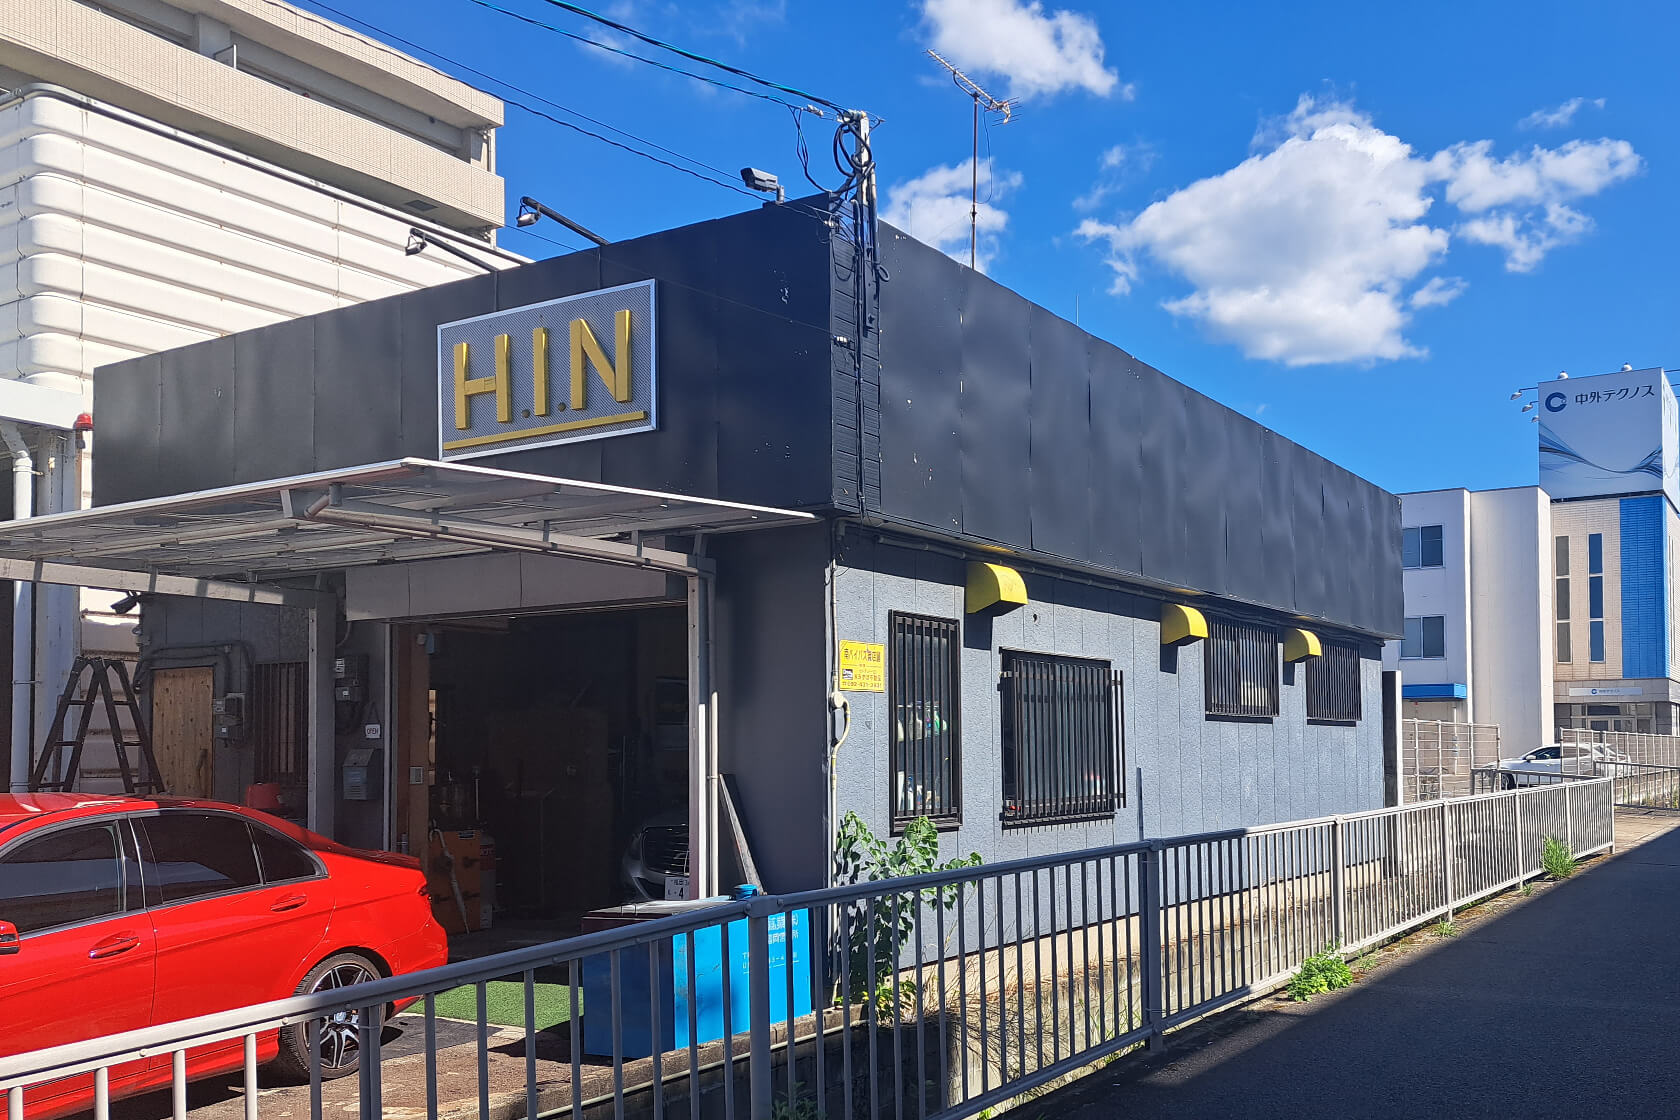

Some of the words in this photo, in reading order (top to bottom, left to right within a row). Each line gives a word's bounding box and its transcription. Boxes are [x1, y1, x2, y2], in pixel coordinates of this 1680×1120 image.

[453, 309, 633, 430] H.I.N
[1575, 385, 1655, 405] 中外テクノス
